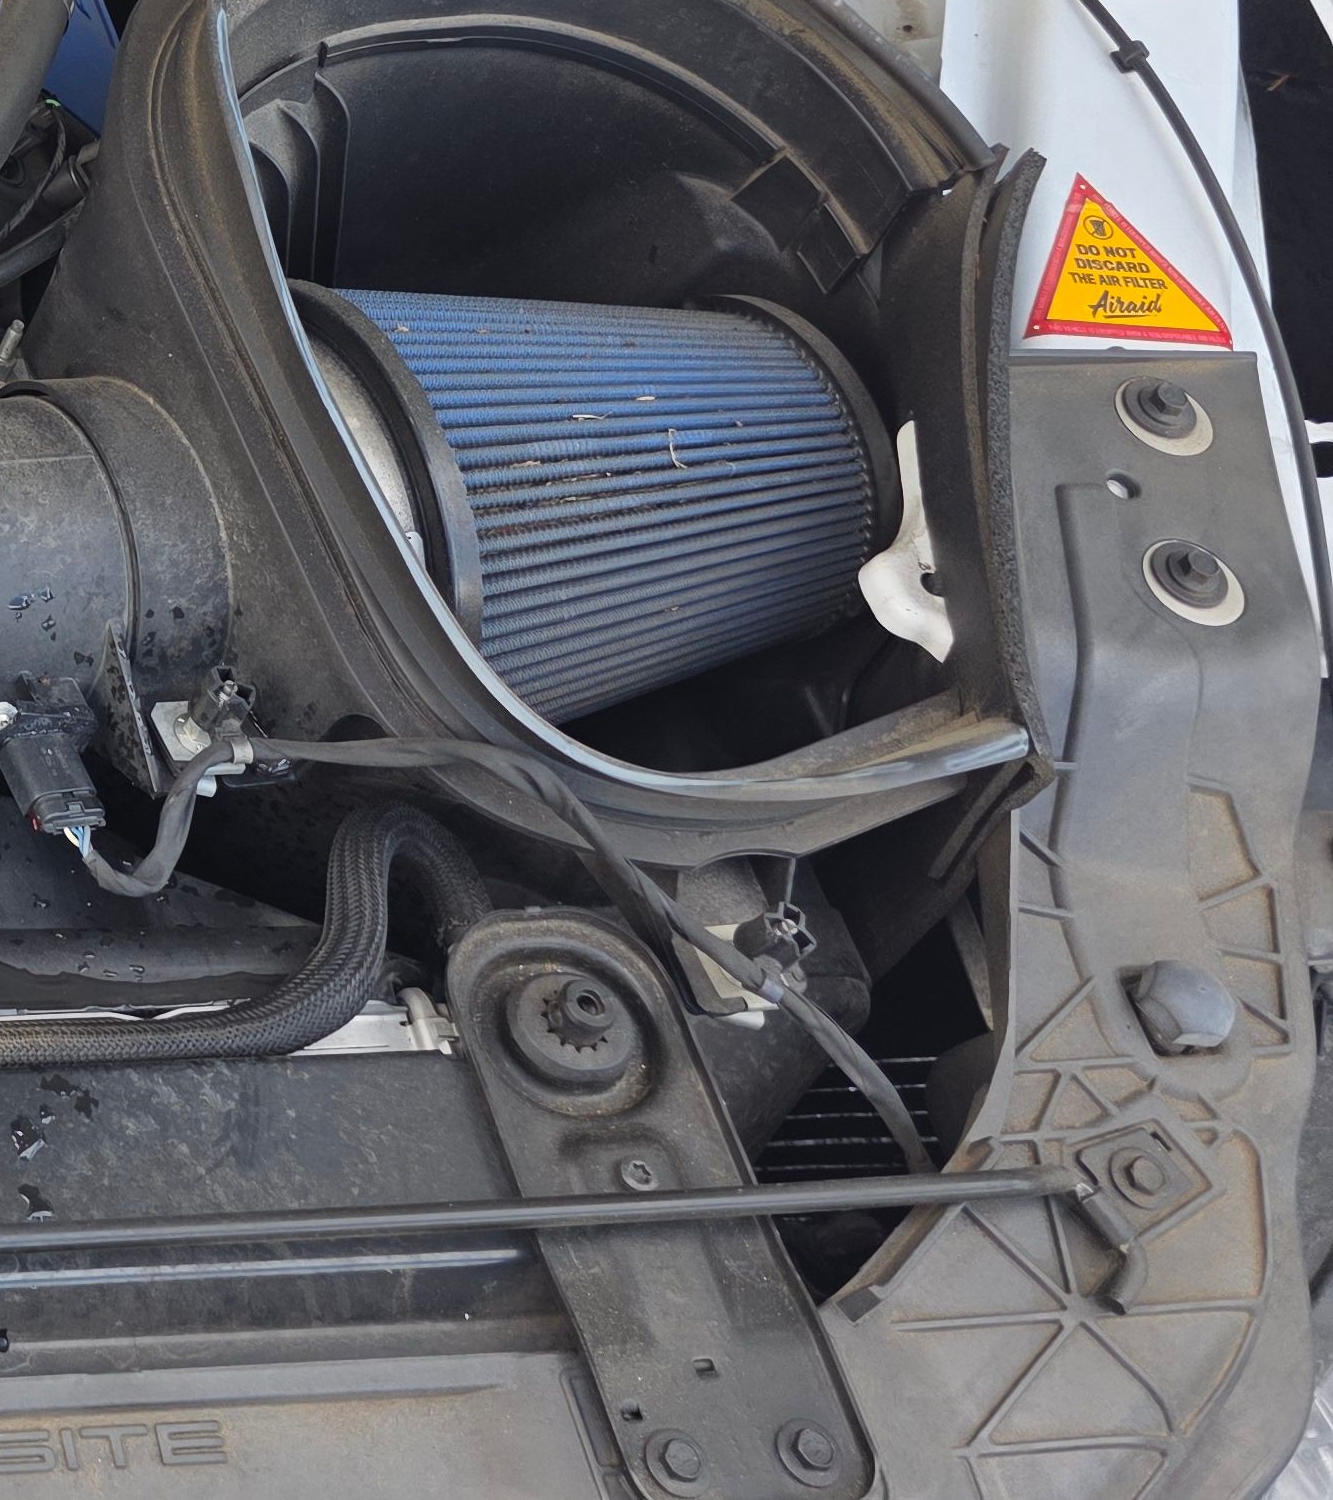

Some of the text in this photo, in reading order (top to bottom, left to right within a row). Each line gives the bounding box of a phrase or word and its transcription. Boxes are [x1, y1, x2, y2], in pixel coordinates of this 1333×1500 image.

[1075, 243, 1137, 259] DO NOT
[1075, 257, 1151, 274] DISCARD
[1067, 271, 1169, 290] THE AIR FILTER
[1088, 290, 1163, 318] Airaid
